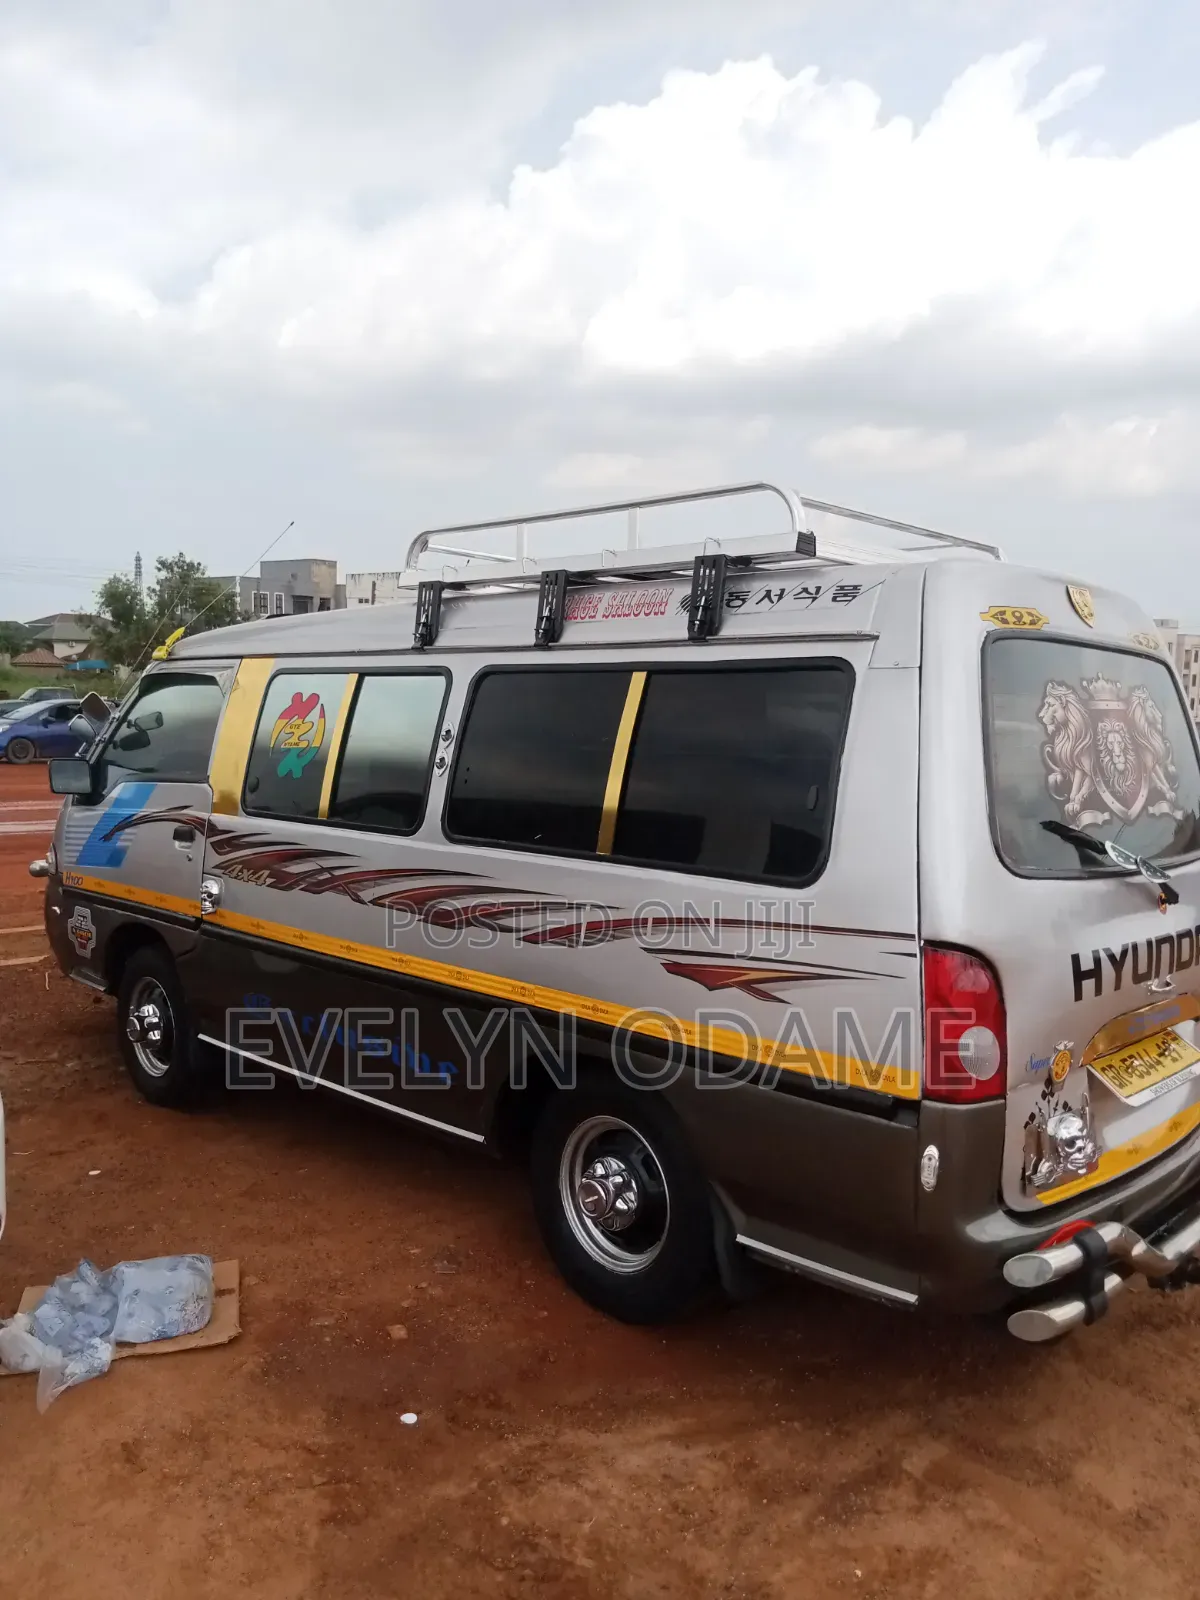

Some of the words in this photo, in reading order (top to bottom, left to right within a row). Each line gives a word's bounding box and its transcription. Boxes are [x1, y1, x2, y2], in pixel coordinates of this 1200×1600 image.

[602, 588, 674, 618] SALOON
[725, 584, 863, 609] 동서식품
[1071, 925, 1200, 1002] HYUND
